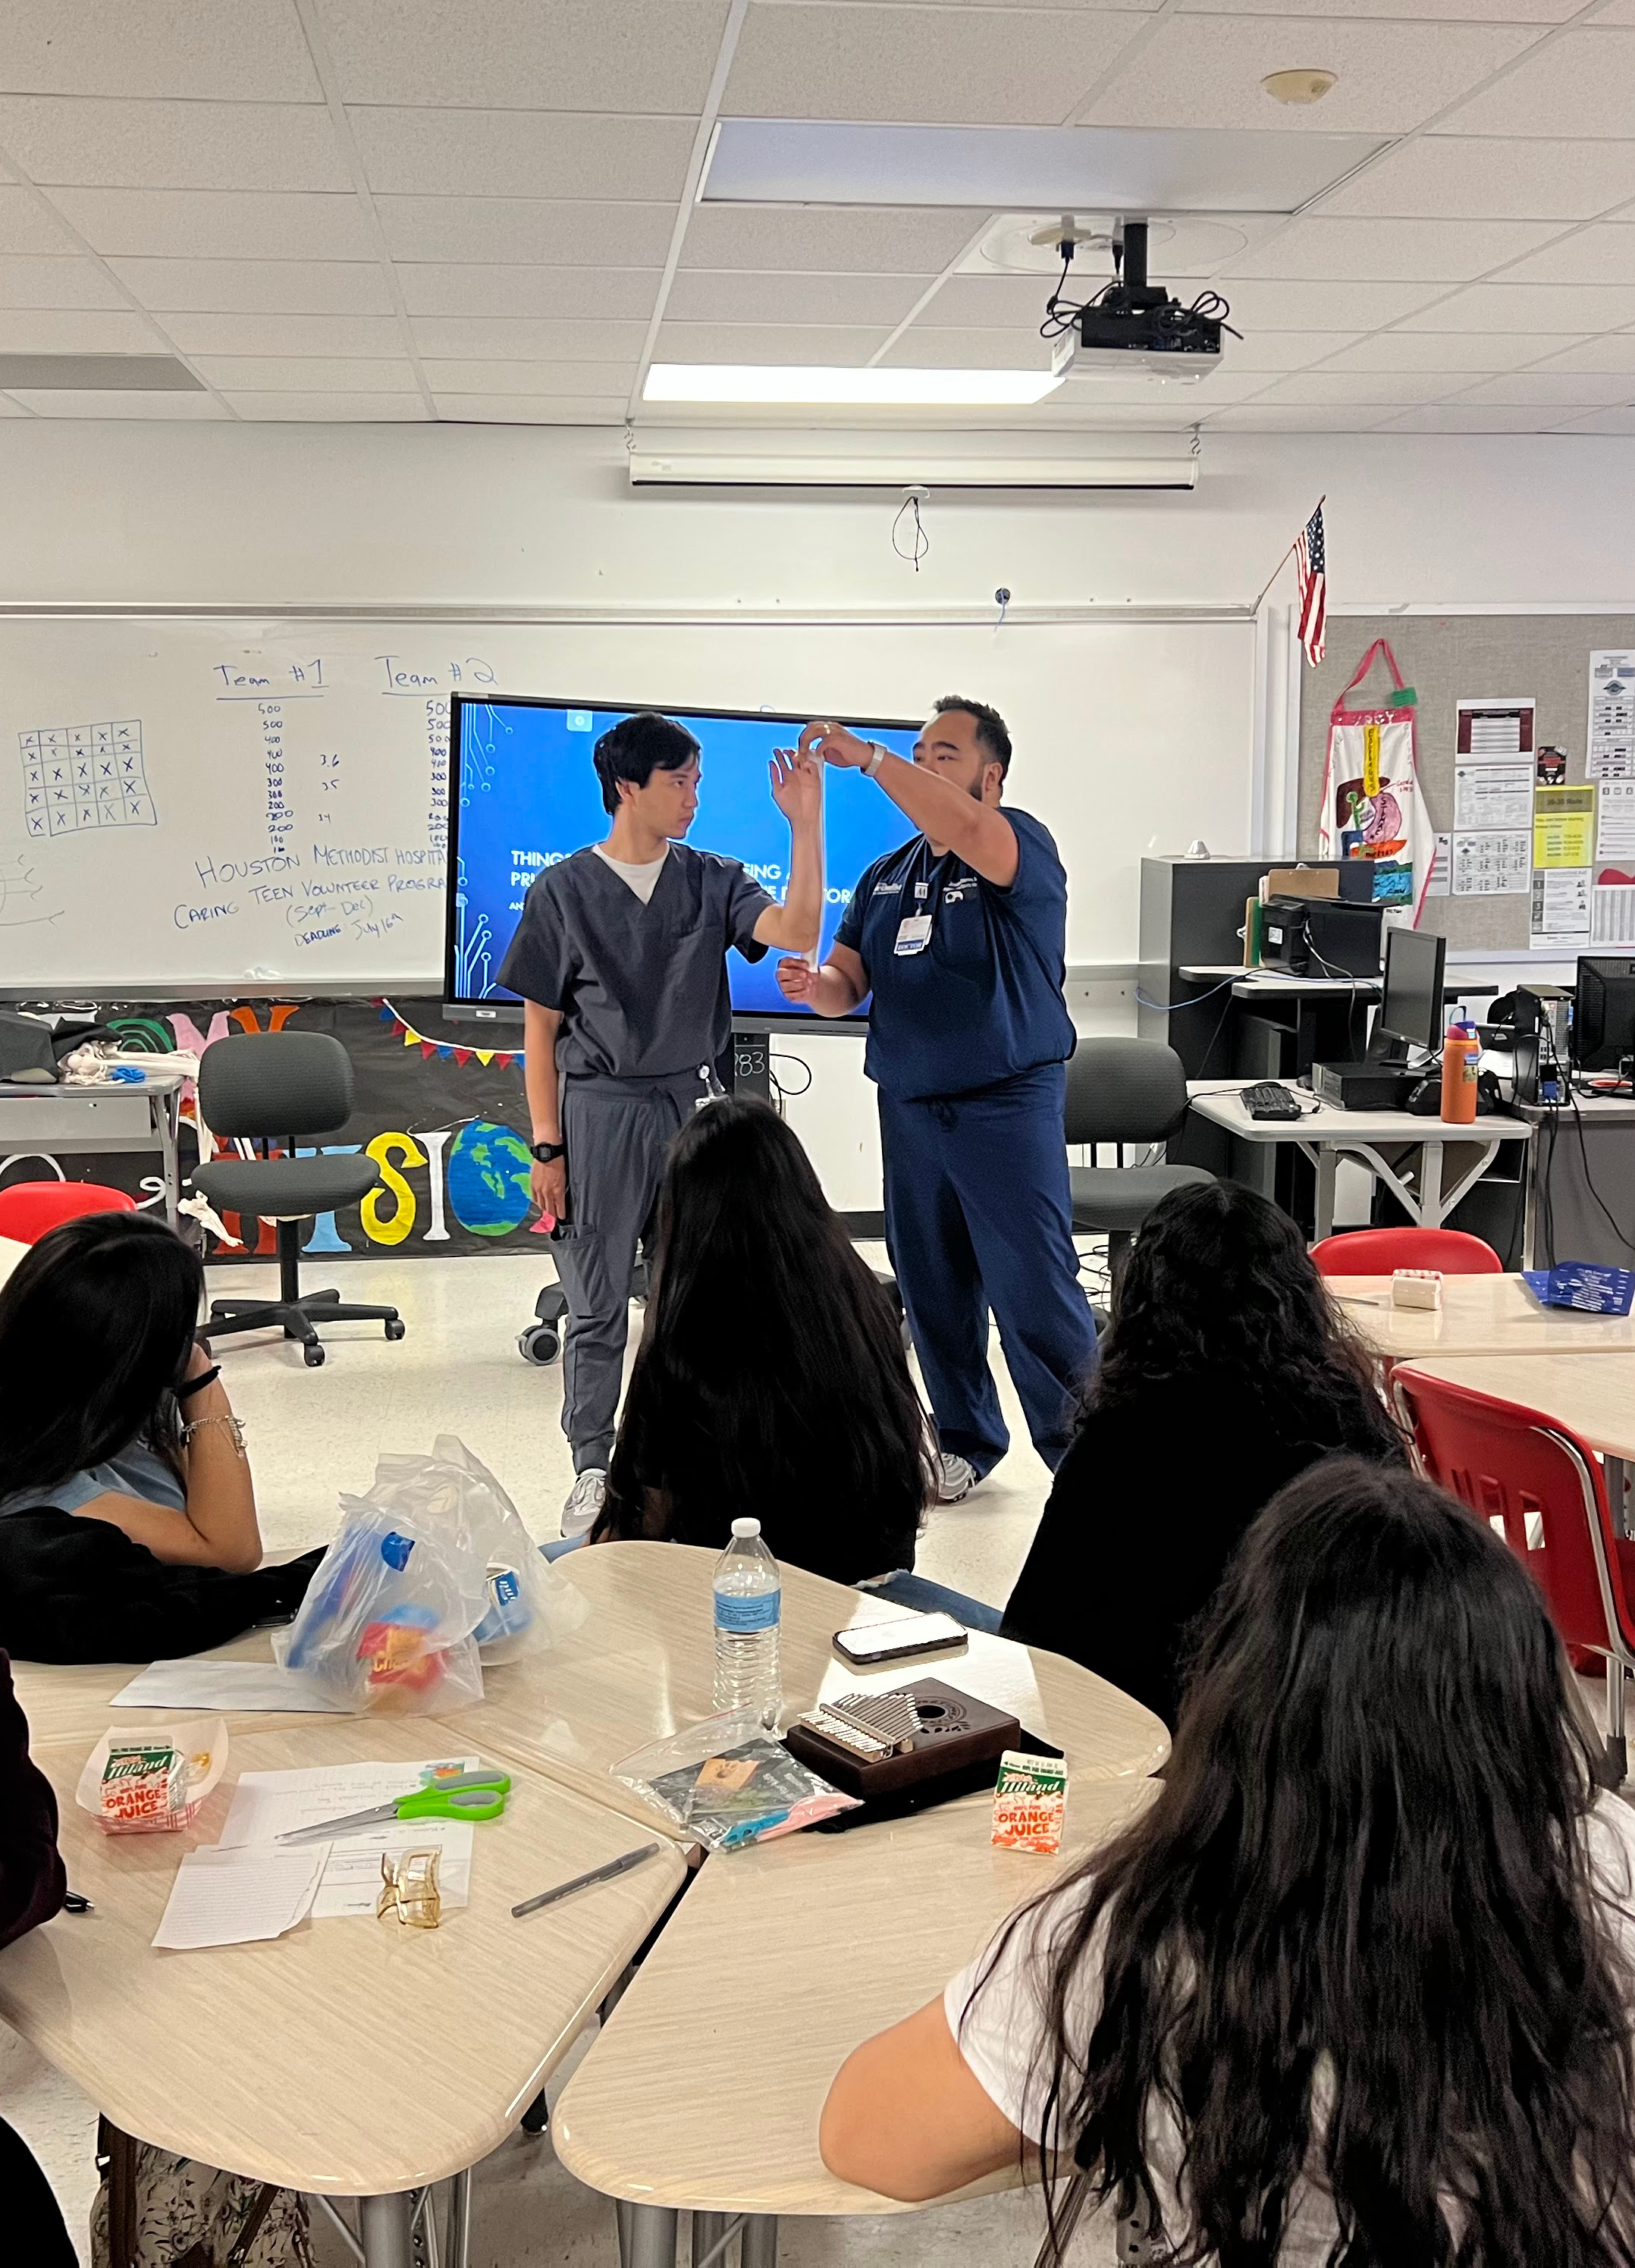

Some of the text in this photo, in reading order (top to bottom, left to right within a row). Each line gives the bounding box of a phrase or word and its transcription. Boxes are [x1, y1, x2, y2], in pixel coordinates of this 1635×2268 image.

[213, 659, 322, 686] Team #1
[375, 655, 498, 689] Team #2
[258, 703, 281, 714] 500
[263, 720, 283, 730] 500
[265, 736, 281, 745] 400
[267, 748, 283, 760] 400
[430, 746, 447, 757] 400
[265, 762, 284, 775] 400
[267, 777, 283, 788] 300
[430, 772, 447, 781] 300
[268, 801, 285, 810] 200
[268, 823, 293, 833] 200
[195, 844, 448, 889] HOUSTON METHODIST HOSPITA
[742, 863, 782, 880] EING
[510, 871, 535, 887] PRI
[174, 874, 446, 929] CARING TEEN VOLUNTEER PROGRA
[509, 902, 524, 911] AN
[351, 919, 381, 940] July
[106, 1789, 162, 1809] ORANGE
[114, 1801, 158, 1819] JUICE
[998, 1810, 1055, 1824] ORANGE
[1005, 1823, 1050, 1836] JUICE
